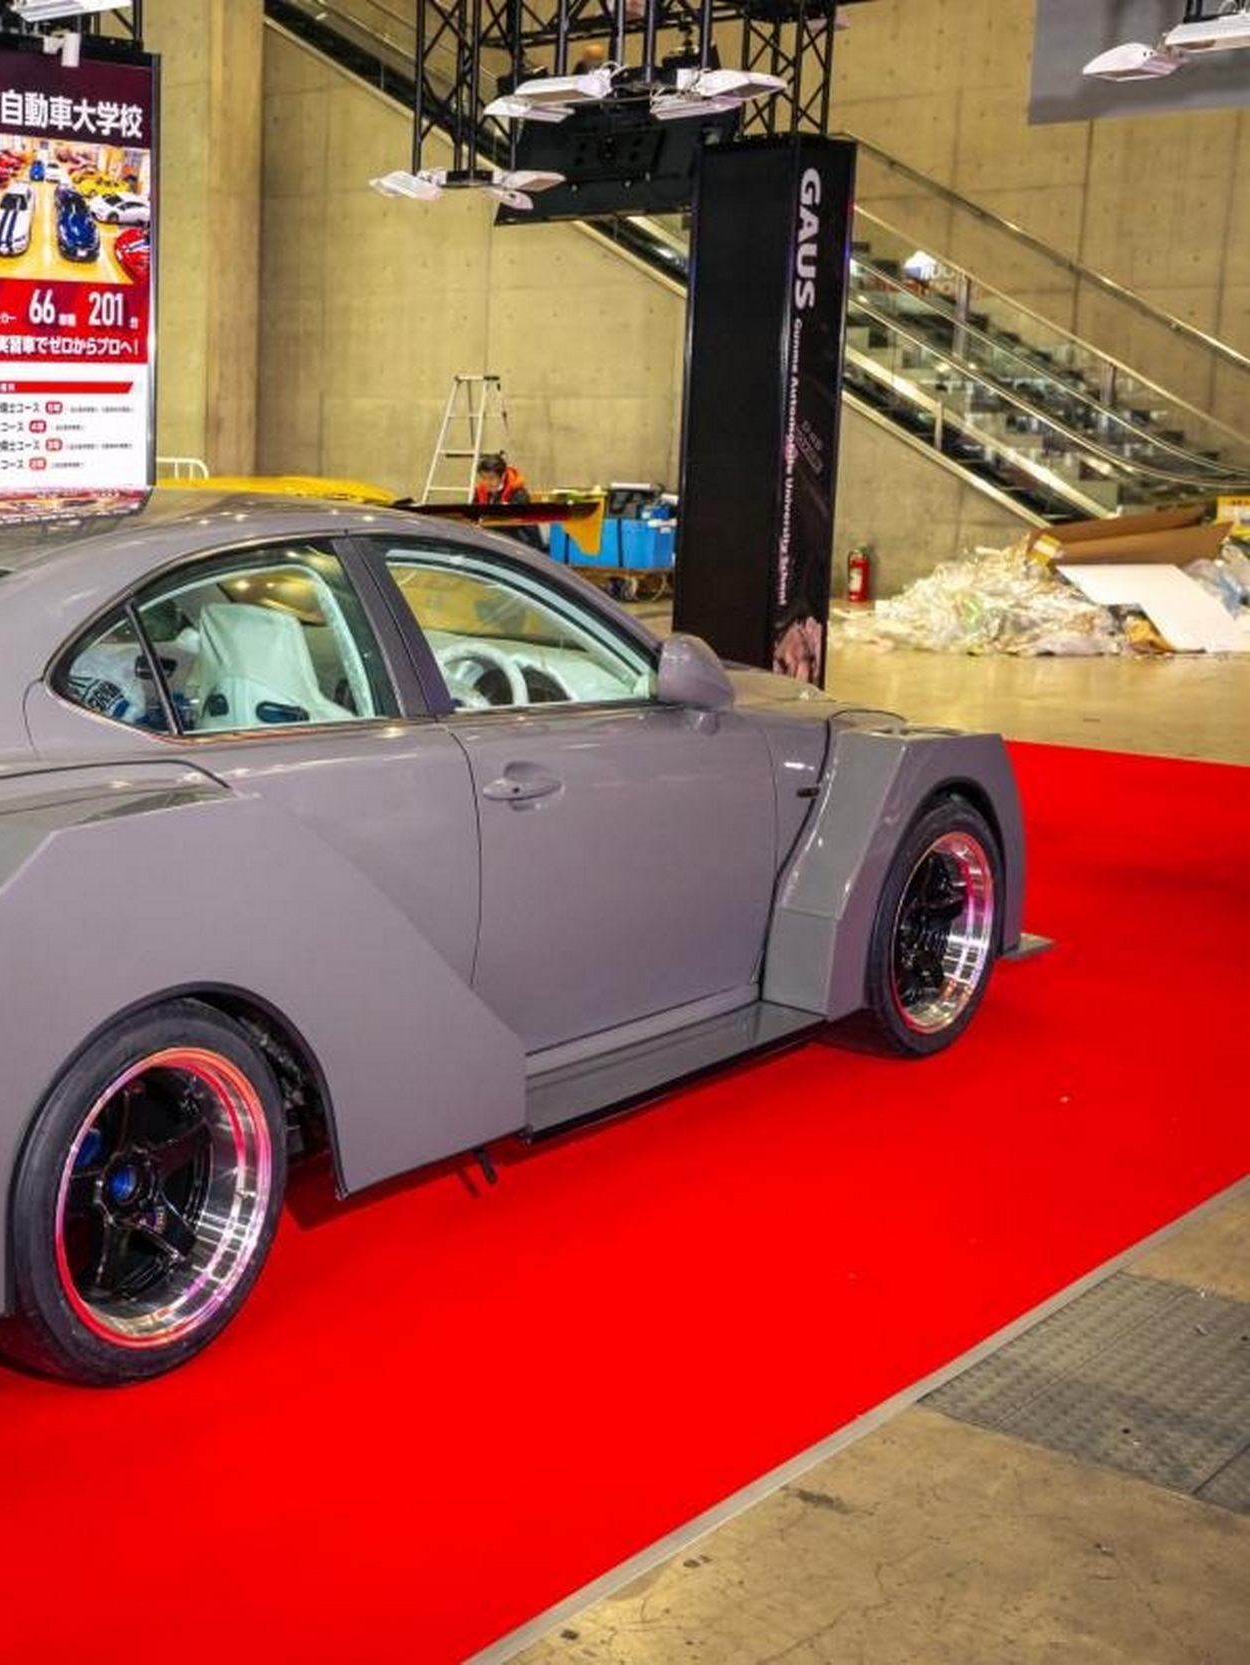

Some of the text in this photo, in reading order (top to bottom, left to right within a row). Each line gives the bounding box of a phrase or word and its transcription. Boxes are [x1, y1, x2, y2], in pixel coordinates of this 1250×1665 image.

[794, 167, 822, 310] GAUS
[29, 289, 56, 324] 66
[88, 292, 124, 326] 201
[791, 317, 804, 373] Gunma
